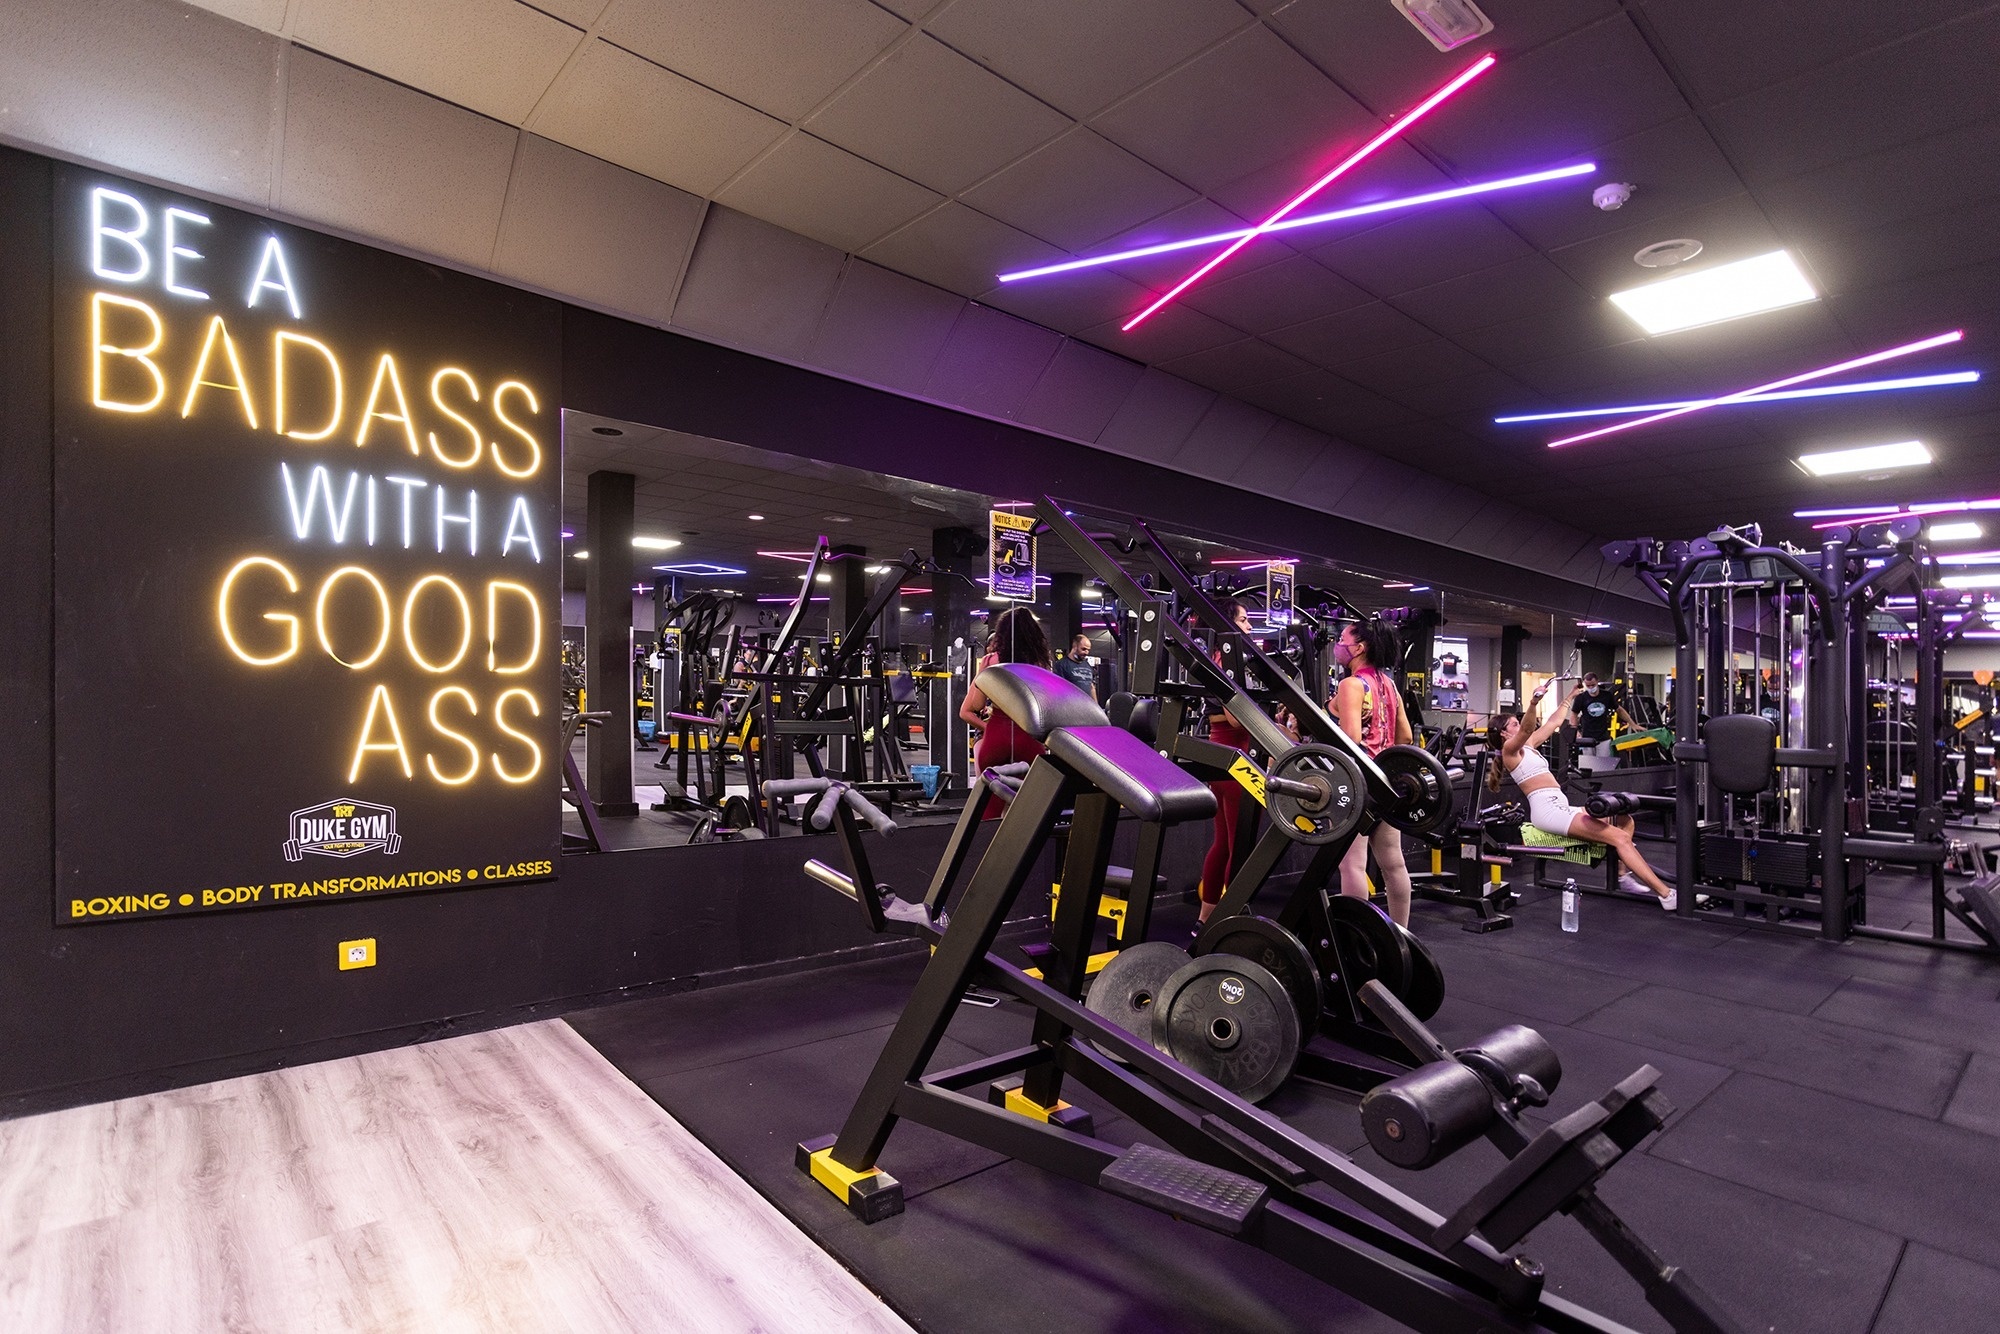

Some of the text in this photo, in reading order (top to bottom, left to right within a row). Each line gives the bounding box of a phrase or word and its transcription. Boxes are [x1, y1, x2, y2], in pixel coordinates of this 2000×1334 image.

[91, 186, 302, 319] BE A
[91, 291, 543, 479] BADASS
[281, 462, 541, 563] WITH A
[995, 514, 1011, 525] NOTICE
[216, 555, 543, 674] GOOD
[348, 684, 543, 786] ASS
[300, 814, 387, 845] DUKE GYM
[71, 861, 552, 918] BOXING BODY TRANSFORMATIONS CLASSES
